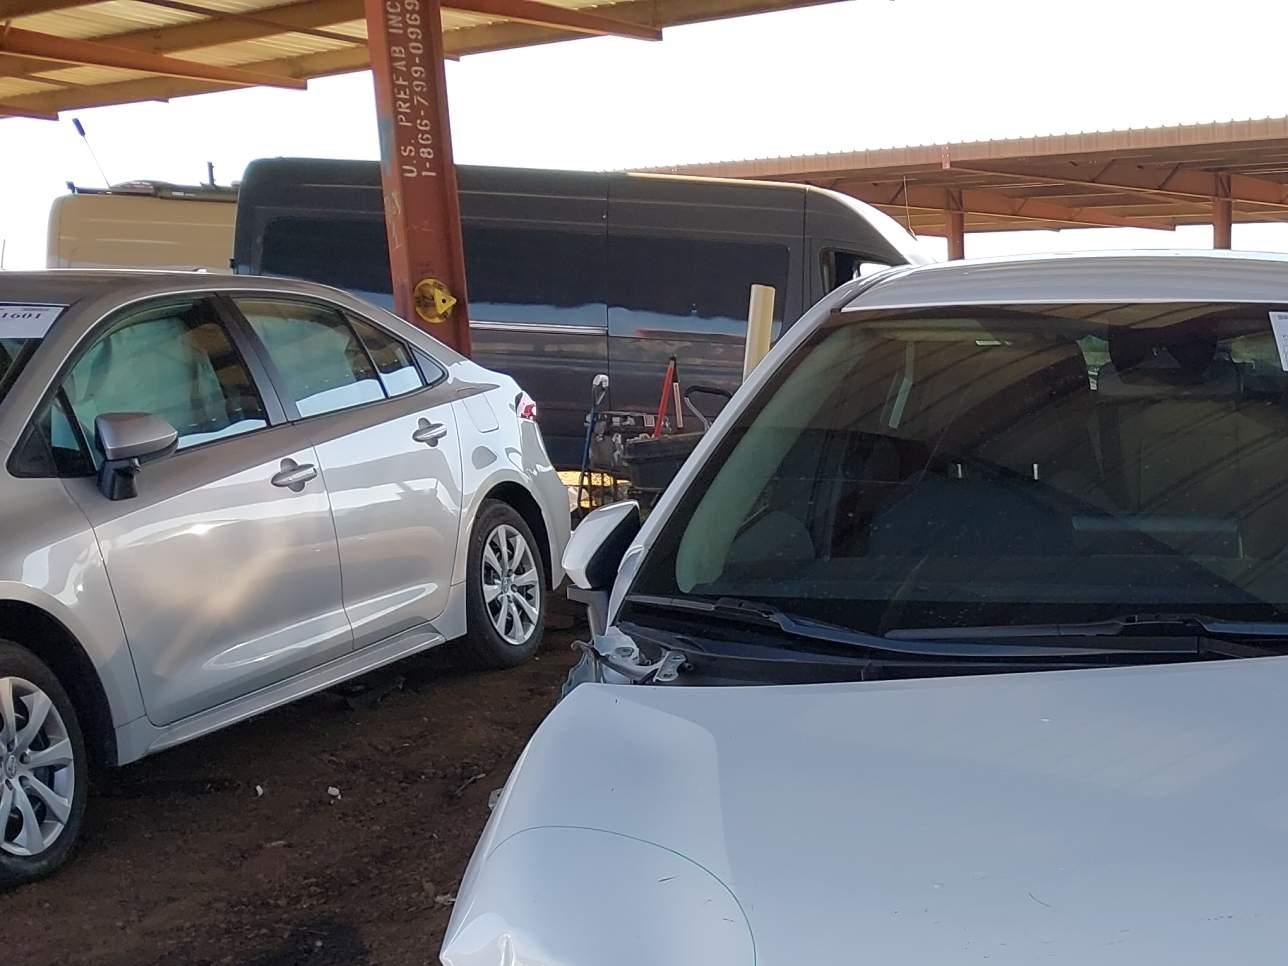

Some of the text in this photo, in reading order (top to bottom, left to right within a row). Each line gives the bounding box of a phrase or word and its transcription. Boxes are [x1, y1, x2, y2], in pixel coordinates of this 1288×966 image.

[391, 47, 413, 127] PREFAB
[404, 0, 437, 177] 1-866-799-0969
[401, 139, 418, 178] U.S.
